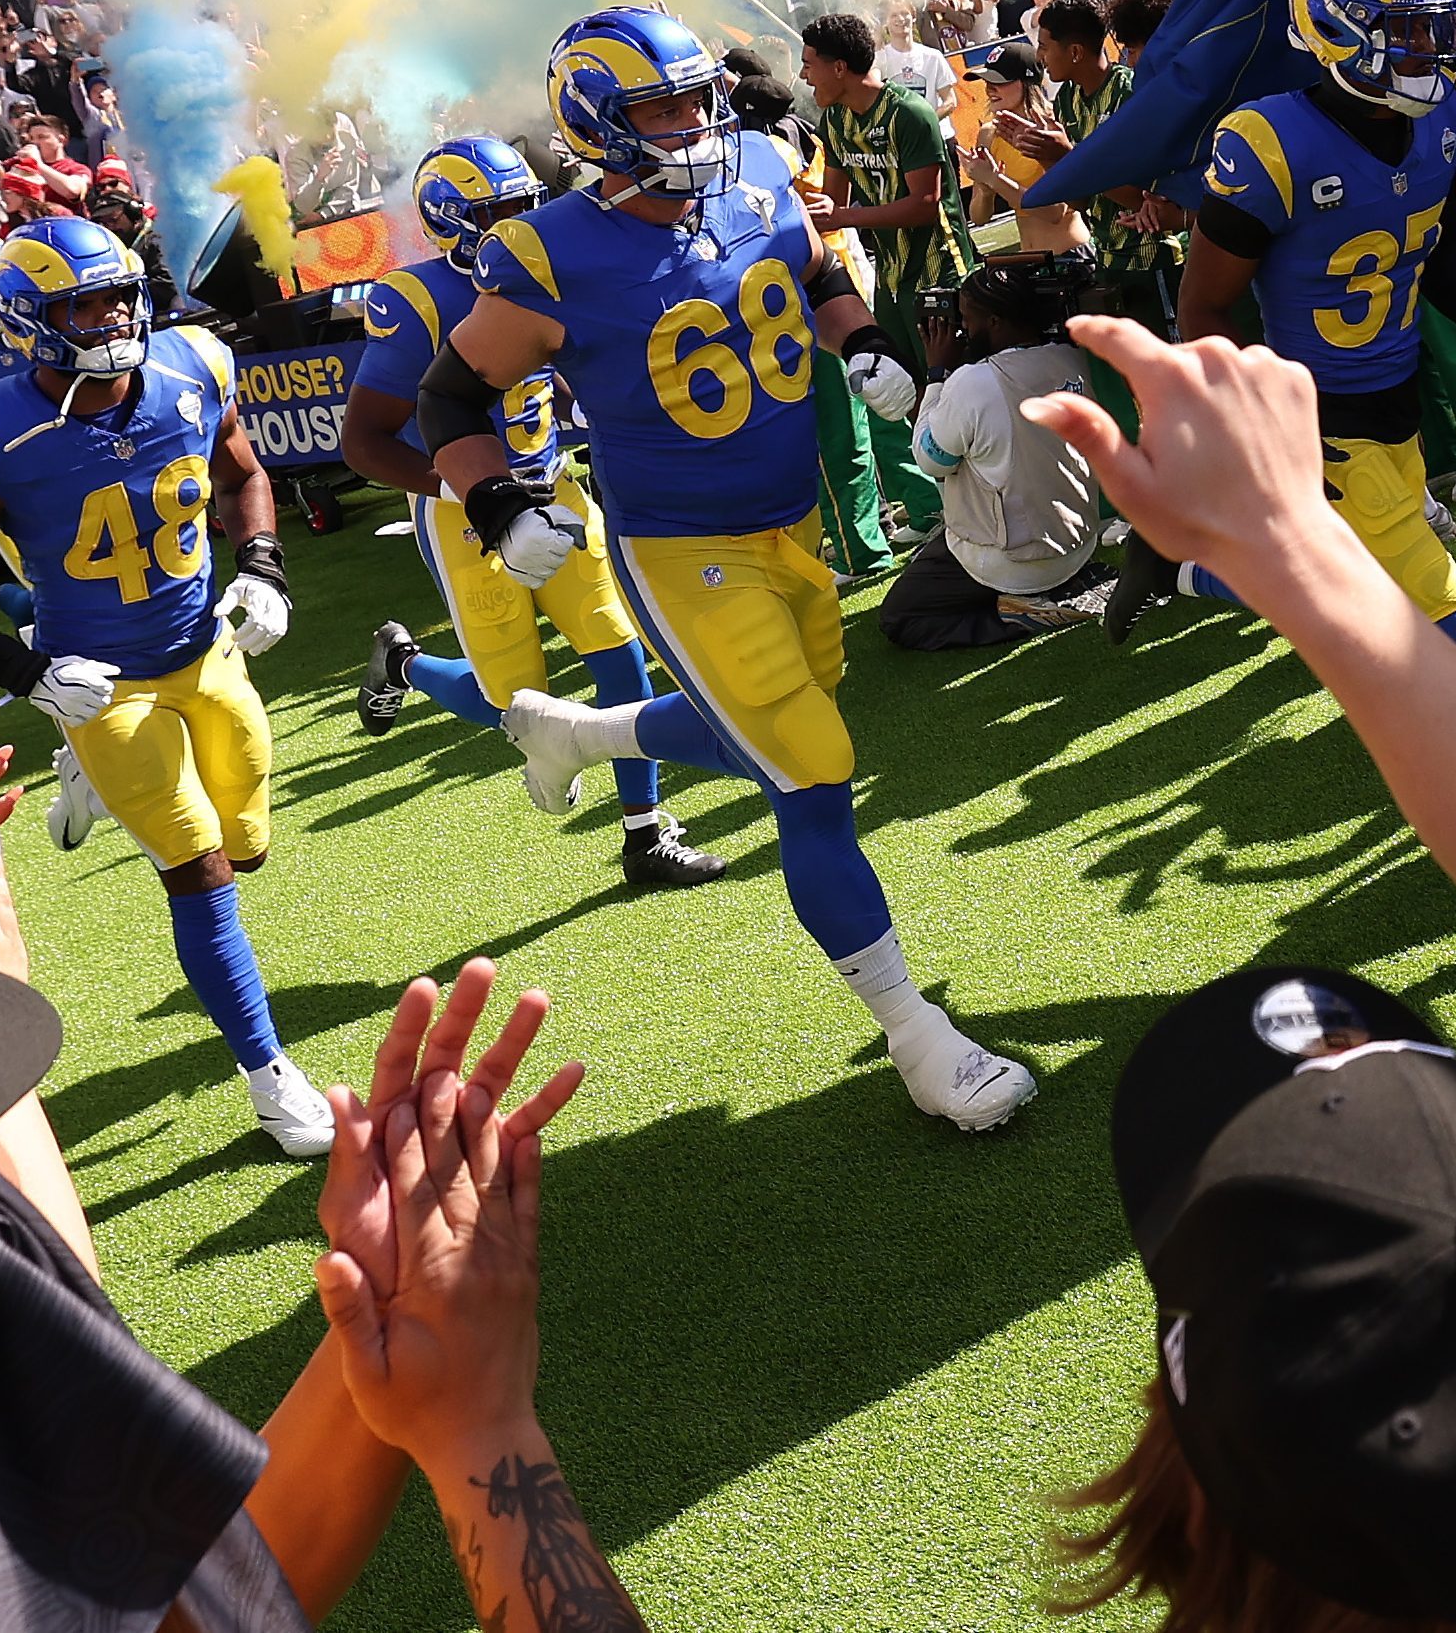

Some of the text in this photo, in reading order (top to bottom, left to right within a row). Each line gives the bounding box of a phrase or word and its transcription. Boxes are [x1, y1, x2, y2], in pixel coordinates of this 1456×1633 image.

[1312, 175, 1343, 204] C
[1313, 197, 1446, 349] 37
[236, 356, 344, 405] HOUSE?
[647, 257, 813, 439] 68
[503, 380, 554, 455] 5
[63, 454, 212, 605] 48
